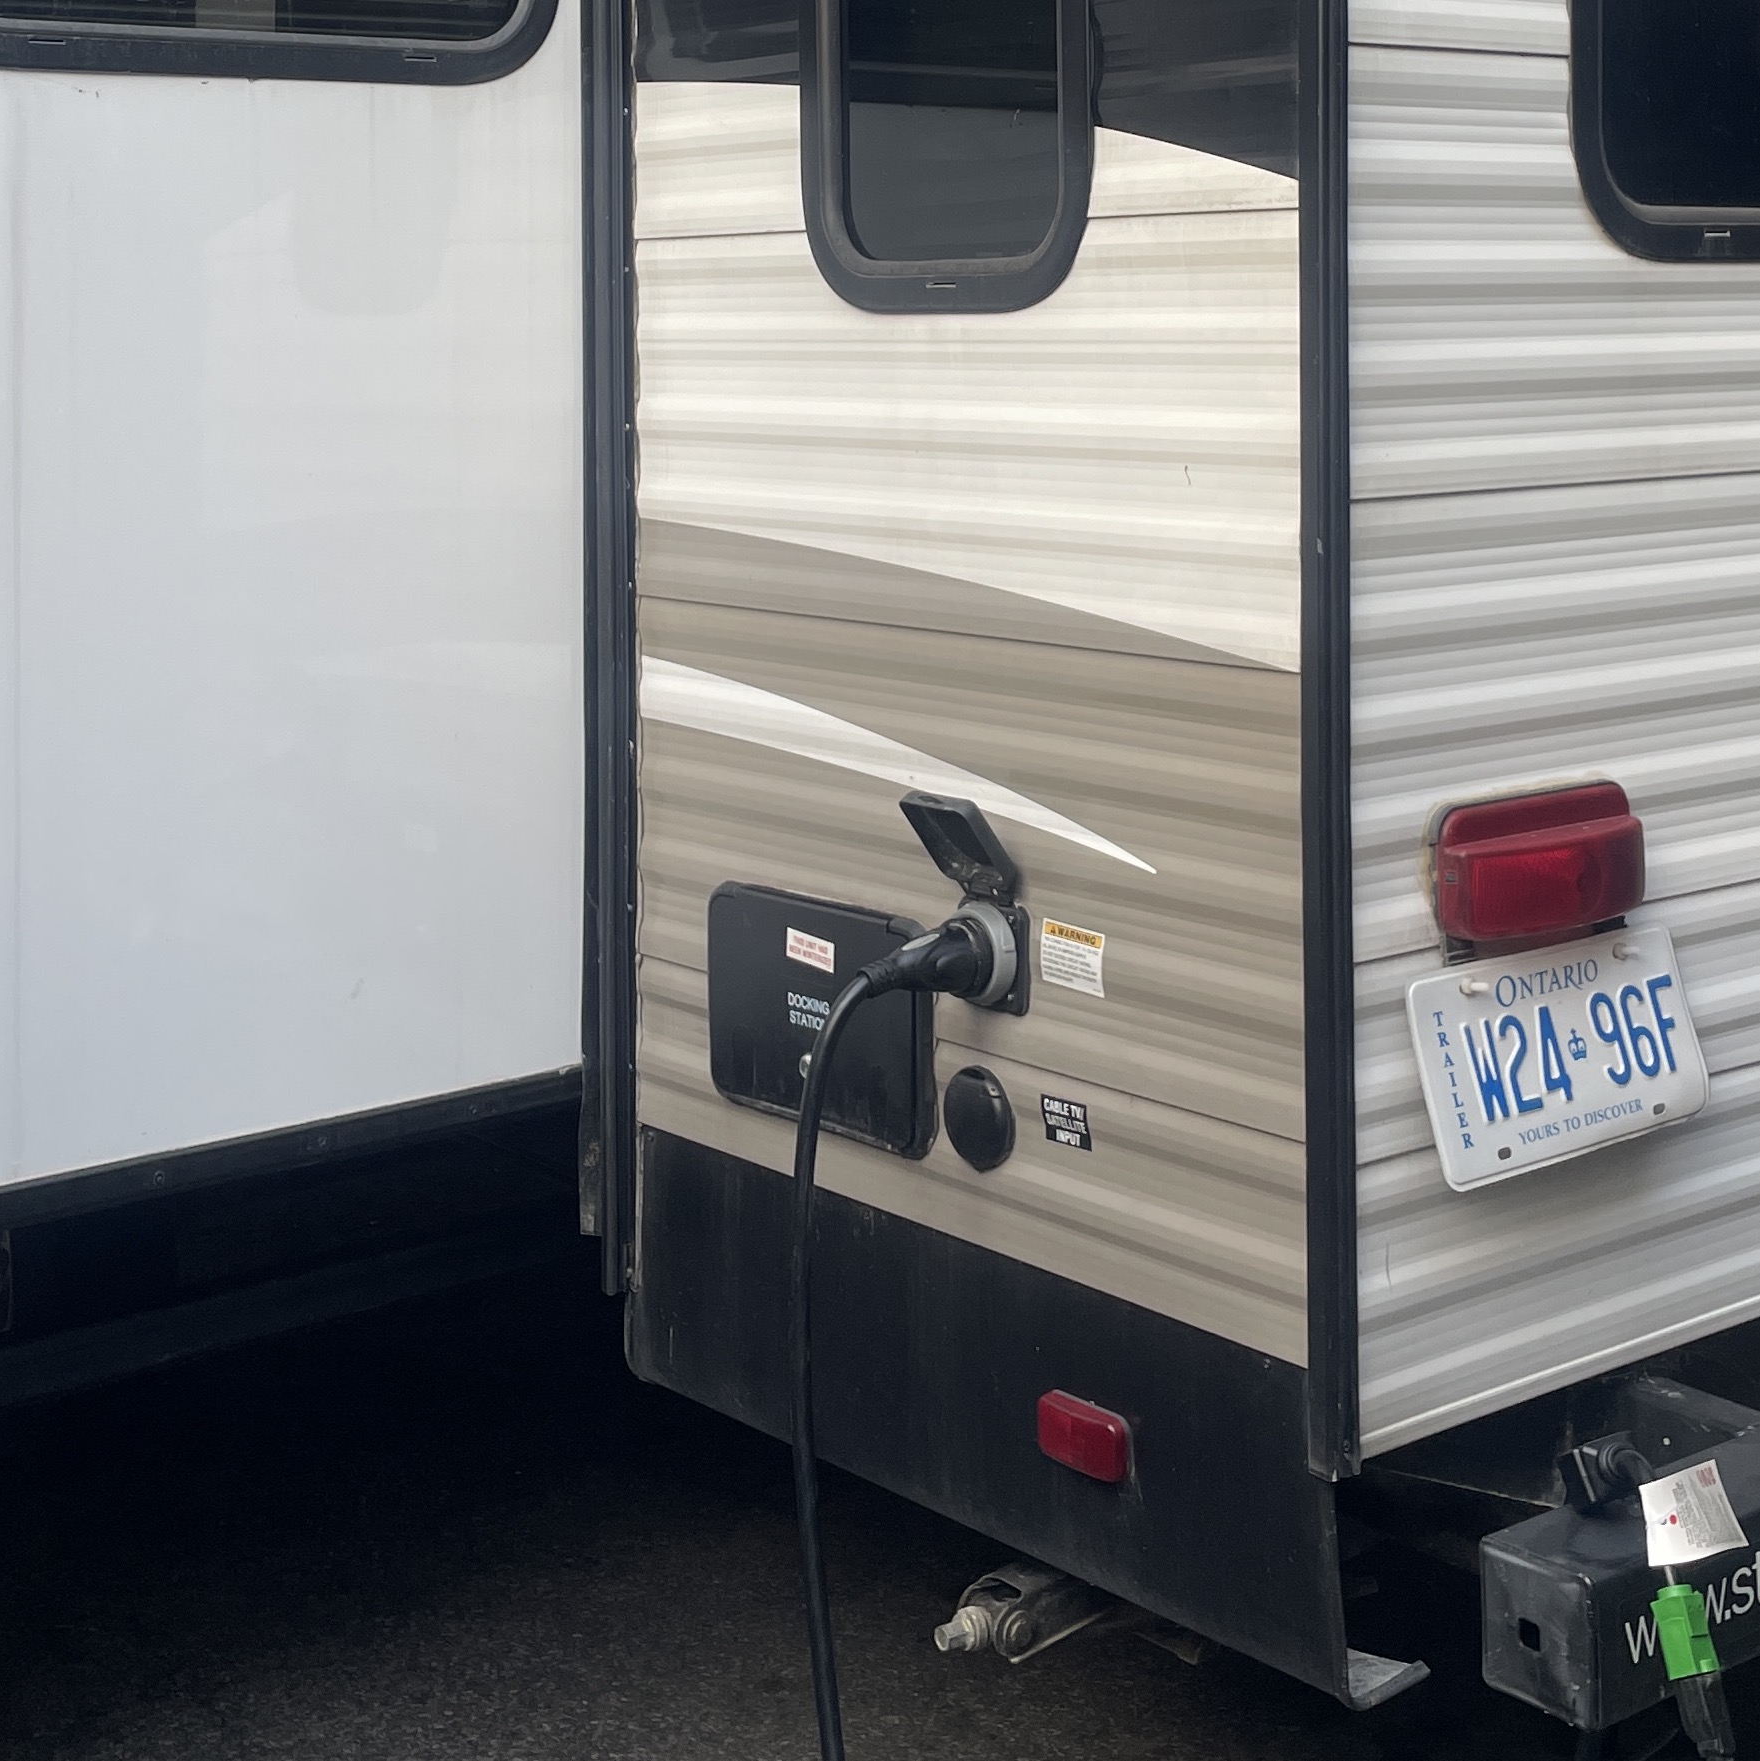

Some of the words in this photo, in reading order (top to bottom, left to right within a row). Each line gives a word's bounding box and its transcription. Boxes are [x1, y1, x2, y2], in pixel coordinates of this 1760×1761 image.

[1058, 926, 1097, 946] WARNING
[1495, 959, 1599, 1007] ONTARIO
[787, 991, 831, 1016] DOCKING
[789, 1009, 825, 1031] STATIO
[1462, 1004, 1573, 1124] W24
[1589, 974, 1677, 1086] 96F
[1432, 1010, 1475, 1150] TRAILER
[1043, 1098, 1070, 1117] CABLE
[1045, 1112, 1088, 1135] SATELLITE
[1518, 1121, 1561, 1145] YOURS
[1563, 1116, 1581, 1133] TO
[1584, 1098, 1644, 1127] DISCOVER
[1055, 1128, 1081, 1147] INPUT
